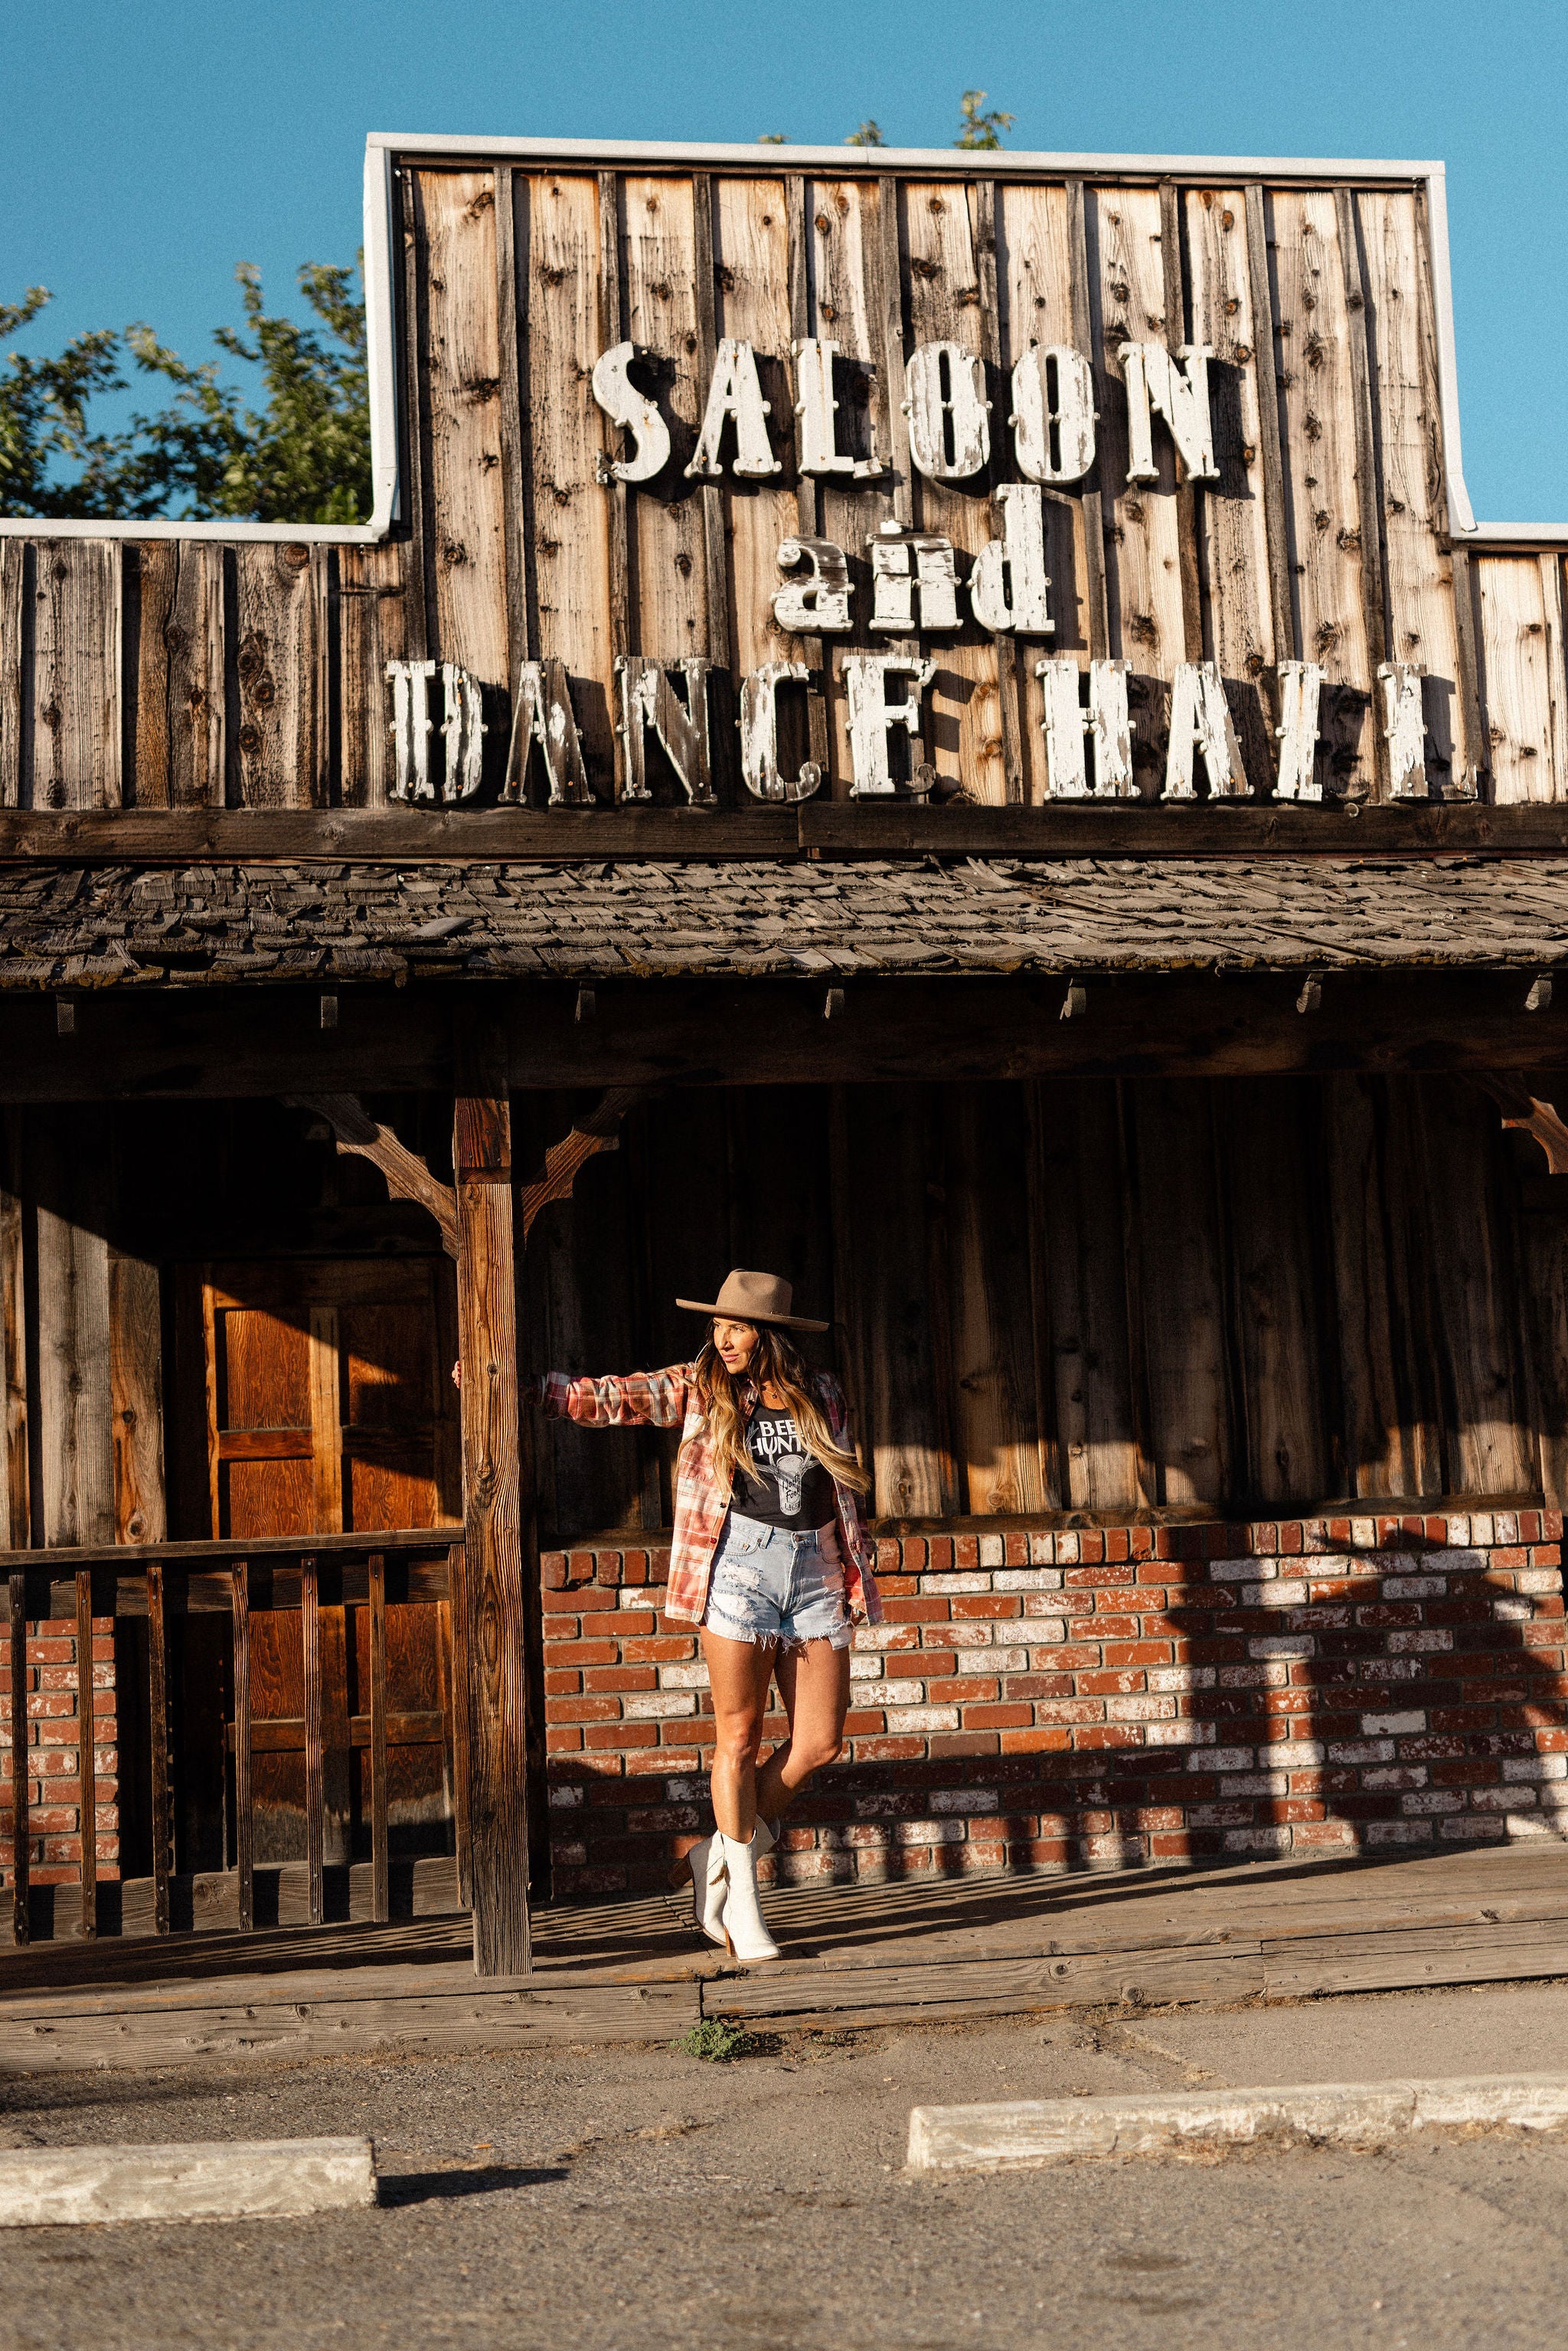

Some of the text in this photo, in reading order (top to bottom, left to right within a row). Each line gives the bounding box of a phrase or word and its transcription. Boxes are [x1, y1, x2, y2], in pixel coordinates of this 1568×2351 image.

[593, 338, 1221, 483] SALOON
[772, 484, 1055, 635] and
[384, 655, 939, 805] DANCE
[750, 1434, 804, 1456] HUNT
[759, 1419, 802, 1437] BEE
